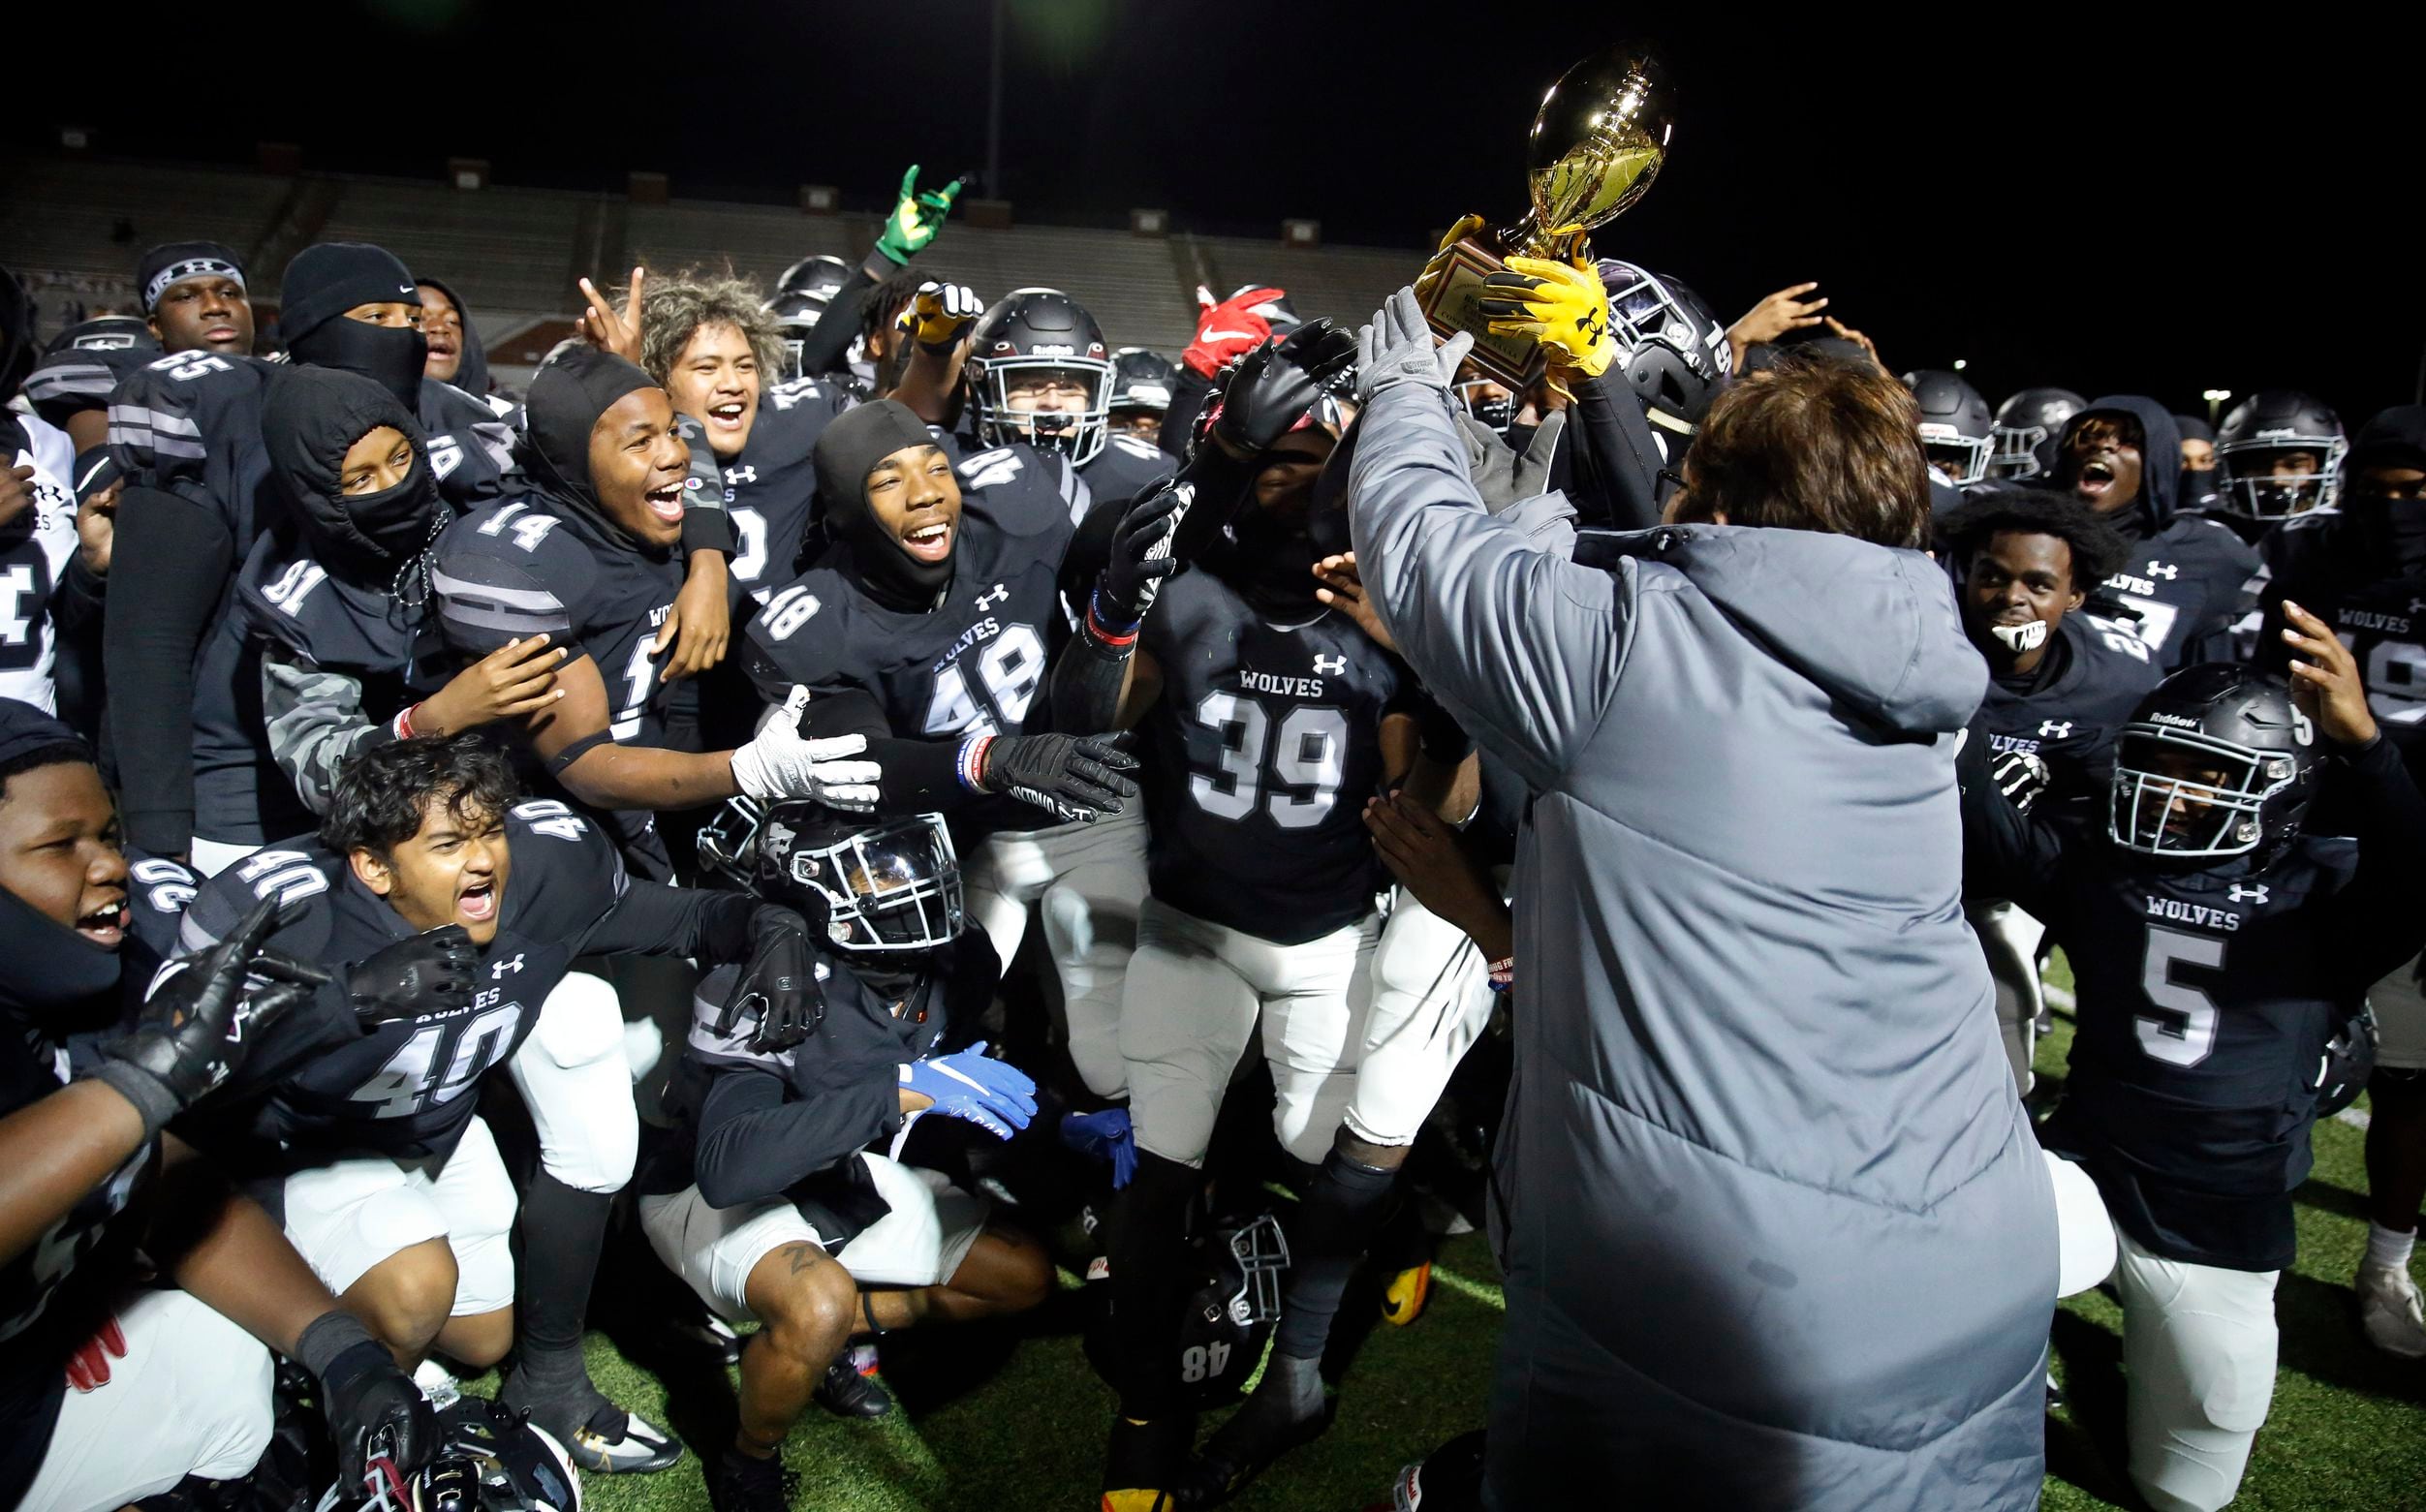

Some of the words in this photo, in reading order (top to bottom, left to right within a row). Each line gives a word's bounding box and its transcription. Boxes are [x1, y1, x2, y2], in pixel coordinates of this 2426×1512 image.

[147, 350, 235, 382] 65
[476, 502, 563, 553] 14
[260, 559, 328, 618] 81
[2100, 572, 2156, 596] LVES
[760, 585, 822, 641] 48
[2338, 608, 2410, 633] WOLVES
[920, 622, 1047, 738] 48
[1239, 669, 1324, 698] WOLVES
[2149, 712, 2200, 727] Riddell
[1188, 689, 1351, 831] 39
[1989, 733, 2041, 755] LVES
[235, 850, 330, 909] 40
[2146, 895, 2241, 932] WOLVES
[2133, 921, 2228, 1069] 5
[349, 1001, 524, 1121] 40
[1182, 1340, 1231, 1383] 48
